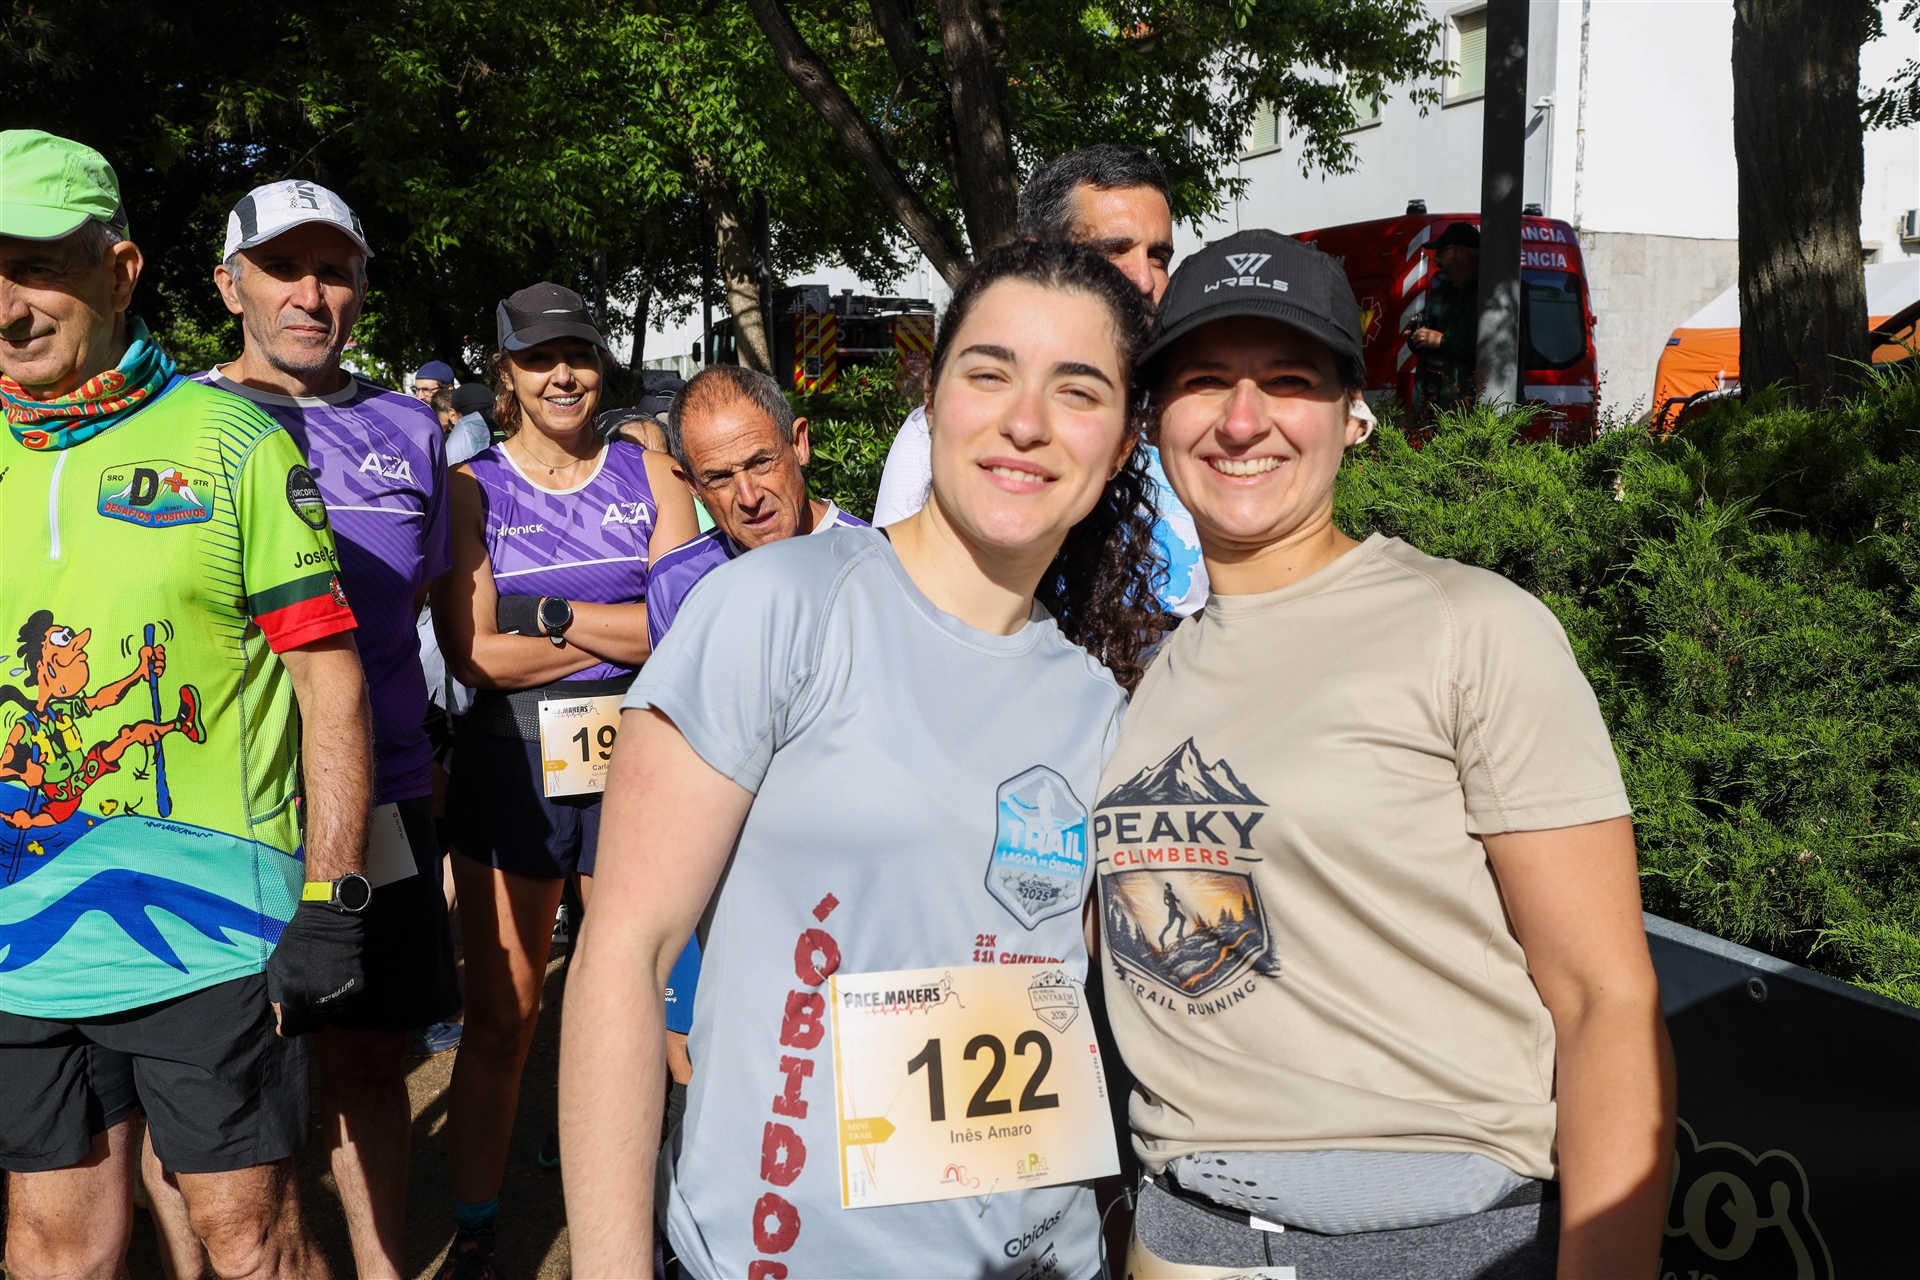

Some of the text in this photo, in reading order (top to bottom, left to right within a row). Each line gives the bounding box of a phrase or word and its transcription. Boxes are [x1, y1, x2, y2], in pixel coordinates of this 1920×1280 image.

[1204, 276, 1289, 293] WRELS
[193, 479, 209, 487] STR
[104, 502, 151, 522] DESAFIOS
[155, 508, 206, 522] POSITIVOS
[55, 758, 99, 801] SRO
[1006, 820, 1083, 862] TRAIL
[1093, 810, 1265, 852] PEAKY
[1002, 850, 1038, 868] LAGOA
[1048, 857, 1081, 875] ÓBIDOS
[1113, 847, 1229, 867] CLIMBERS
[1022, 888, 1050, 902] 2025
[975, 933, 997, 948] 22K
[1033, 991, 1073, 1002] SANTARÉM
[1129, 978, 1257, 1015] TRAIL RUNNING
[907, 1029, 1060, 1122] 122
[748, 892, 841, 1280] ÓBIDO
[847, 1122, 869, 1131] MINI
[848, 1131, 874, 1140] TRAIL
[950, 1124, 1032, 1144] Inês Amaro
